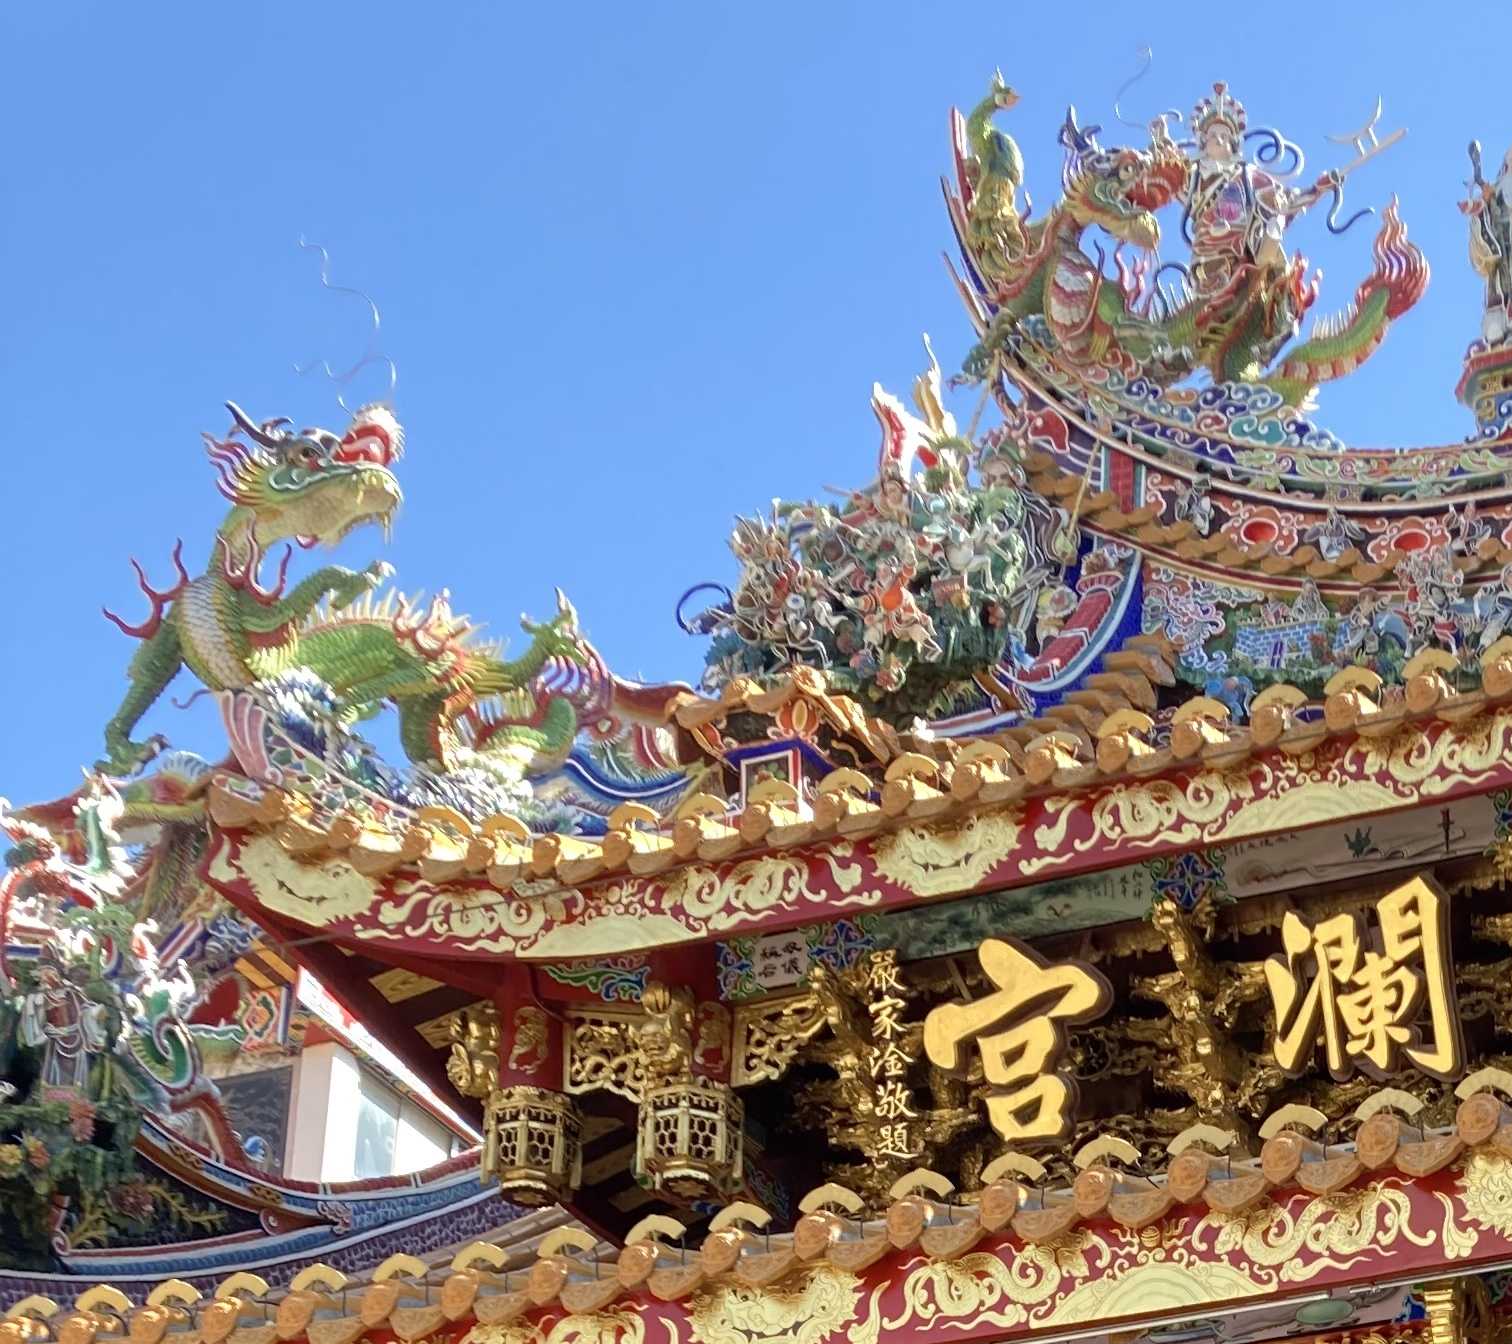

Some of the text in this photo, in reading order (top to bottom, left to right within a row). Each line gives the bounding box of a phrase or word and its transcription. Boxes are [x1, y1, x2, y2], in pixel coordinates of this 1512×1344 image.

[866, 950, 919, 1160] 嚴家淦敬題
